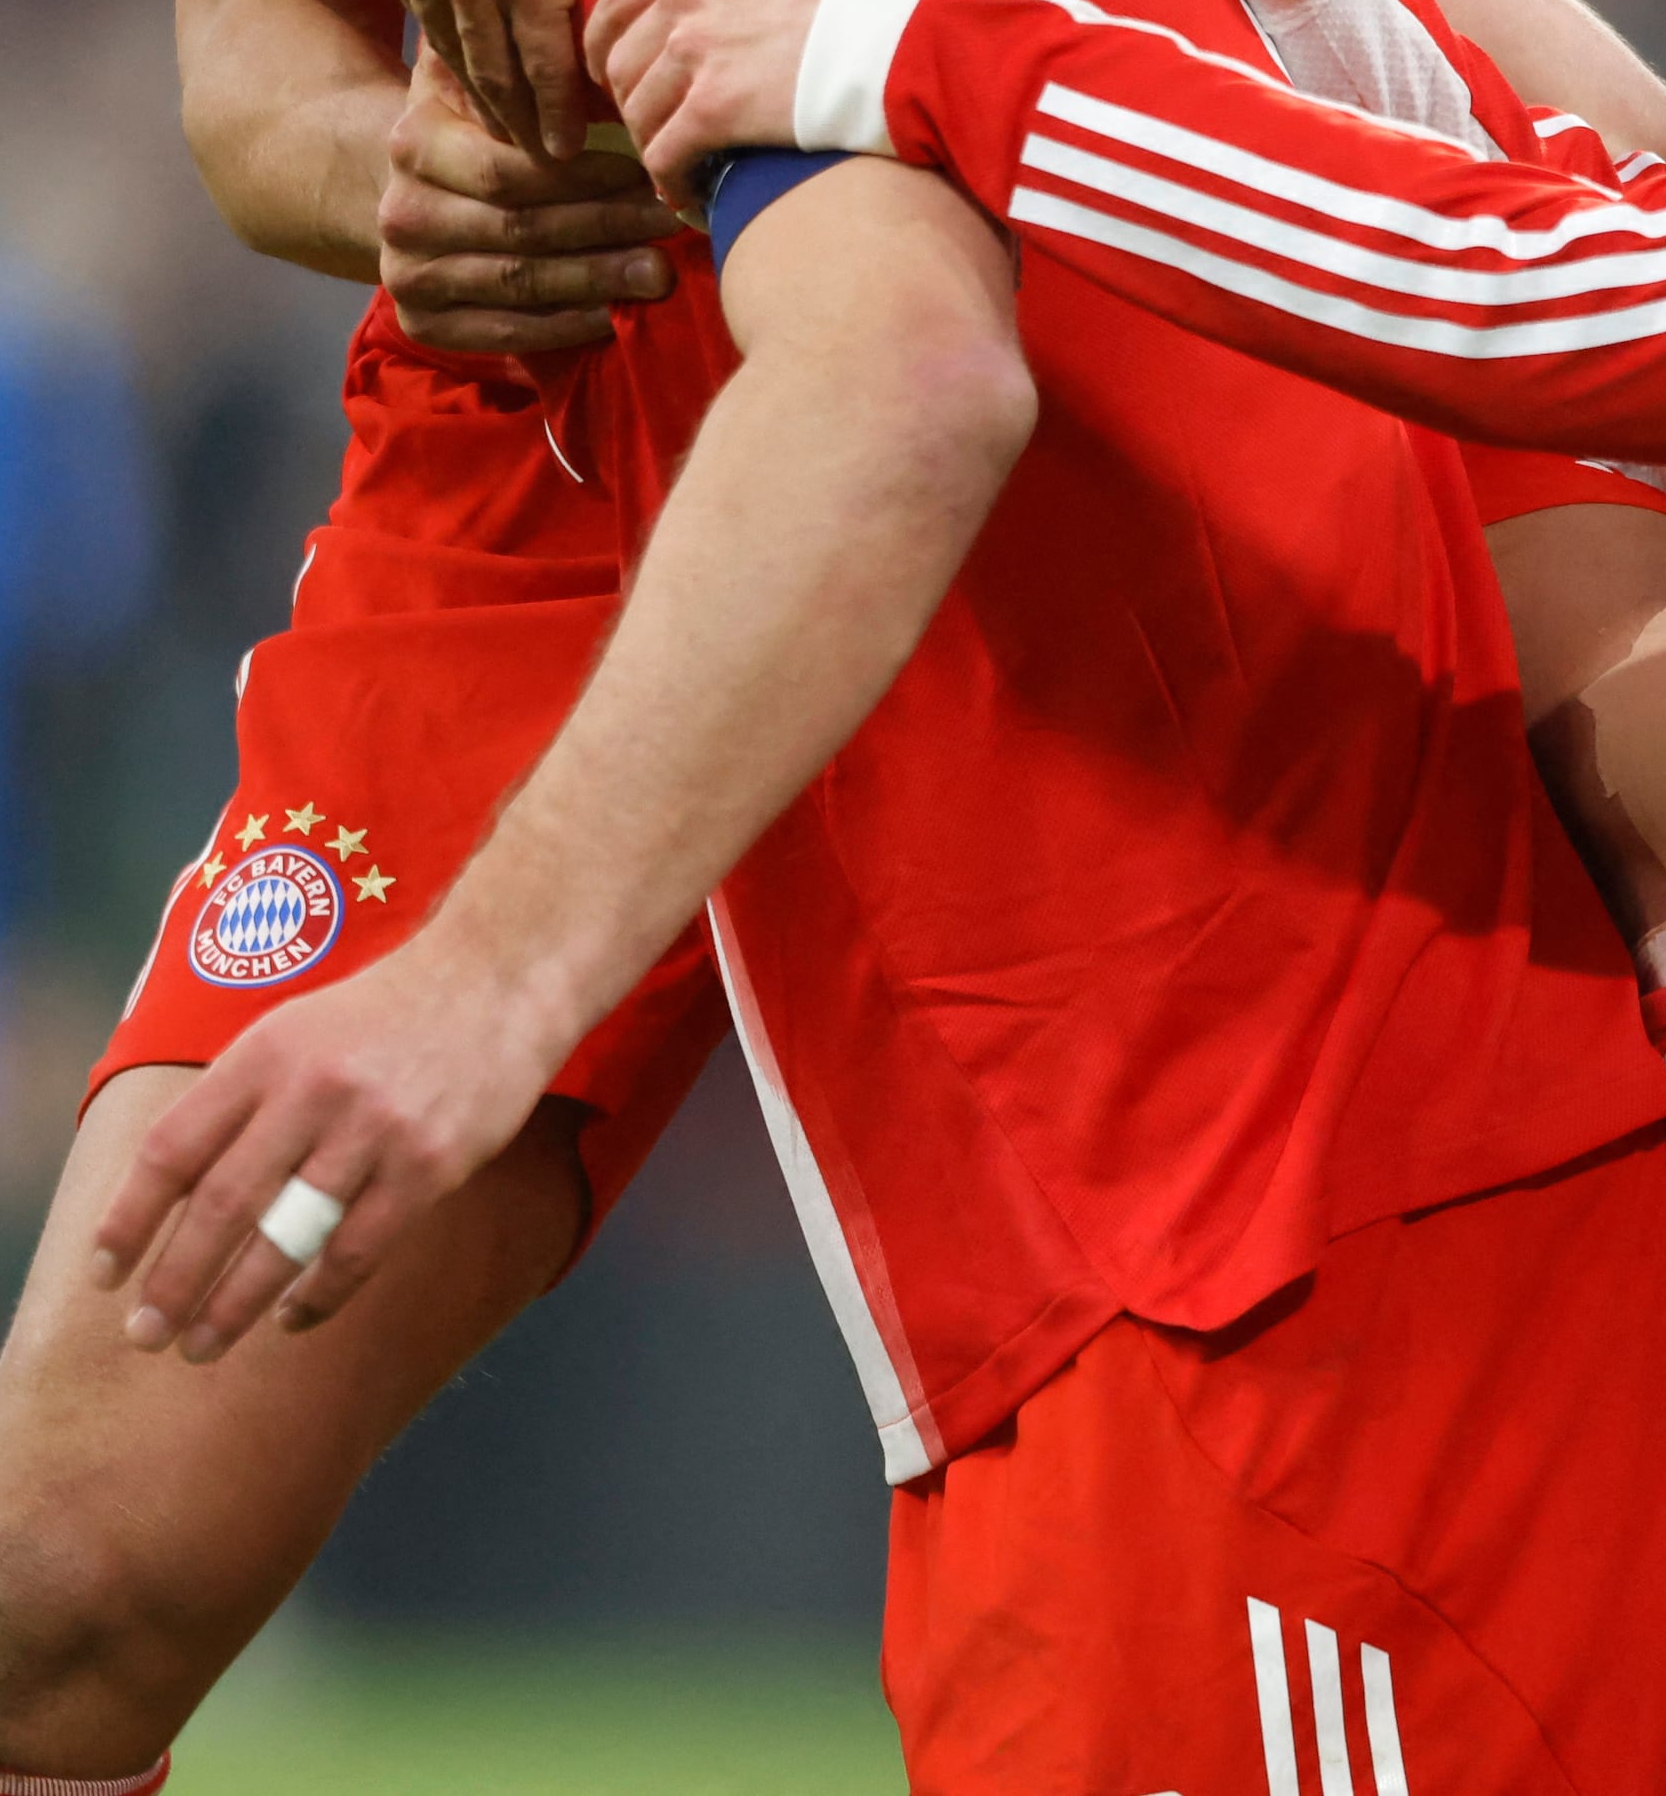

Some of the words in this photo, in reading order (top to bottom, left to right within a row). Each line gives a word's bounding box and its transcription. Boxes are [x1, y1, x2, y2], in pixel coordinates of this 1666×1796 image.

[213, 873, 244, 907] FC
[251, 855, 330, 916] BAYERN
[197, 928, 313, 978] MÜNCHEN
